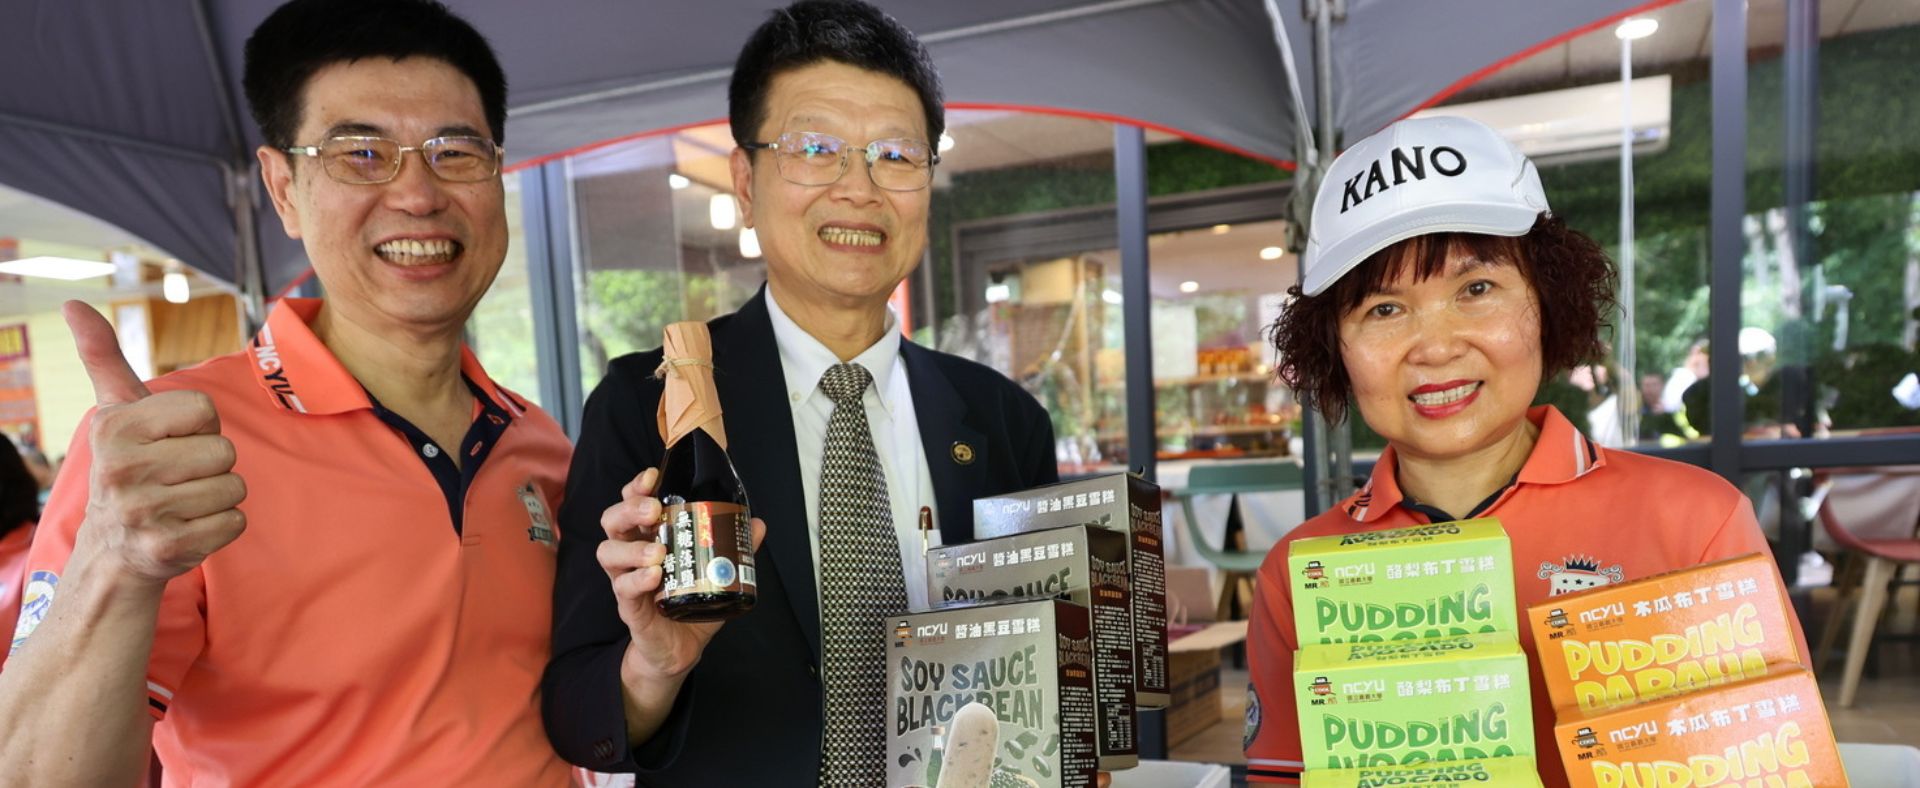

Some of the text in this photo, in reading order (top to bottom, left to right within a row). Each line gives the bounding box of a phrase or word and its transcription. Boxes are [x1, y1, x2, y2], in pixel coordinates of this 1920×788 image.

[1340, 146, 1467, 214] KANO
[254, 345, 294, 394] NCYU
[956, 551, 986, 567] ncyu
[993, 542, 1075, 567] 醬油黑豆雪糕
[1334, 561, 1376, 578] ncyu
[1386, 555, 1496, 580] 酪梨布丁雪糕
[1315, 582, 1492, 633] PUDDING
[1632, 577, 1759, 617] 木瓜布丁雪糕
[1579, 602, 1625, 624] ncyu
[917, 622, 948, 637] ncyu
[955, 617, 1041, 639] 醬油黑豆雪糕
[1562, 602, 1765, 681] PUDDING
[901, 644, 1037, 692] SOY SAUCE
[1342, 679, 1385, 694] ncyu
[1396, 674, 1512, 697] 酪梨布丁雪糕
[1323, 702, 1507, 751] PUDDING
[1666, 693, 1801, 736] 木瓜布丁雪糕
[1609, 721, 1659, 743] ncyu
